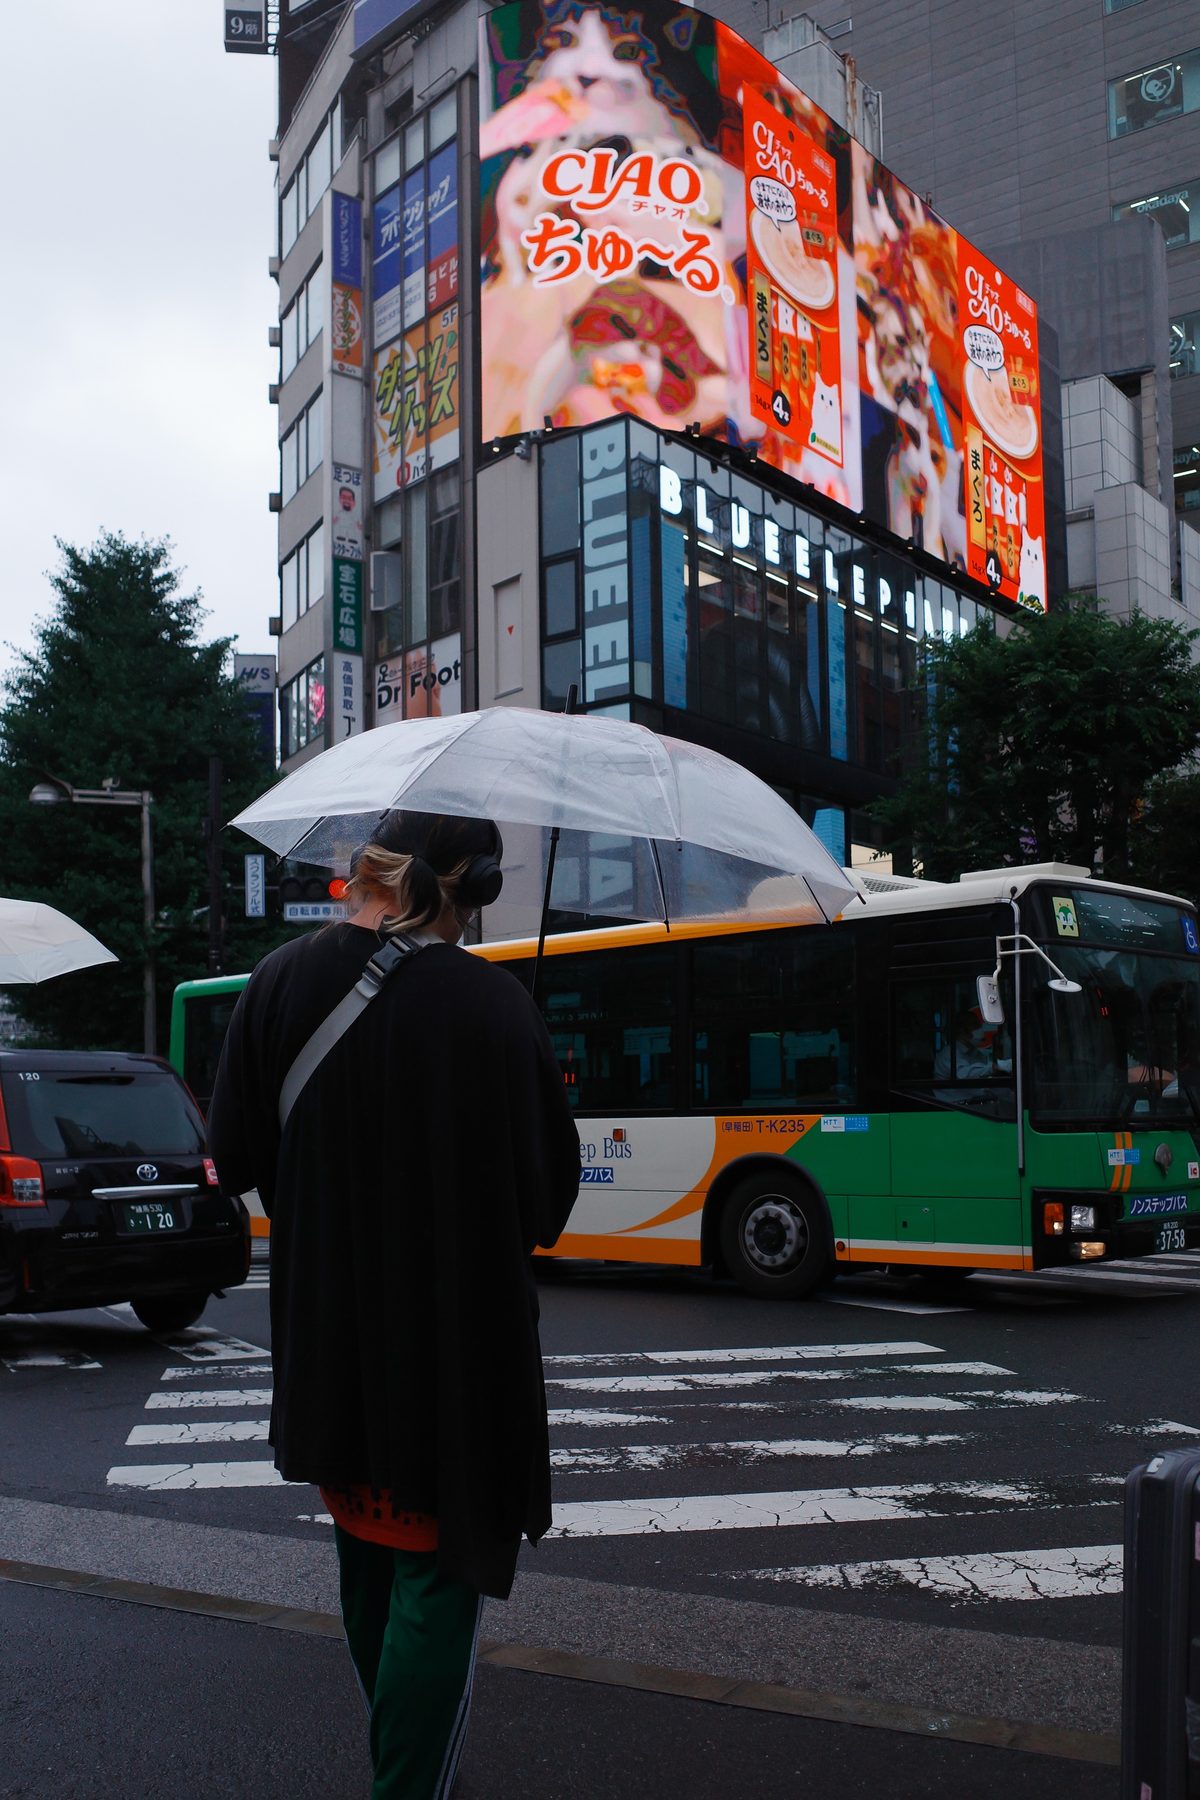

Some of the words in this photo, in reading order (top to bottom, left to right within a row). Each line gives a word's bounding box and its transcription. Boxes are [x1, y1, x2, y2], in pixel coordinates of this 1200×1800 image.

[542, 152, 702, 210] CIAO
[442, 304, 458, 329] 5F
[378, 684, 401, 710] Dr
[410, 659, 462, 698] Foot
[18, 1072, 40, 1081] 120
[756, 1120, 805, 1133] T-K235
[603, 1138, 632, 1159] Bus
[1130, 1196, 1188, 1214] ノンステップバス
